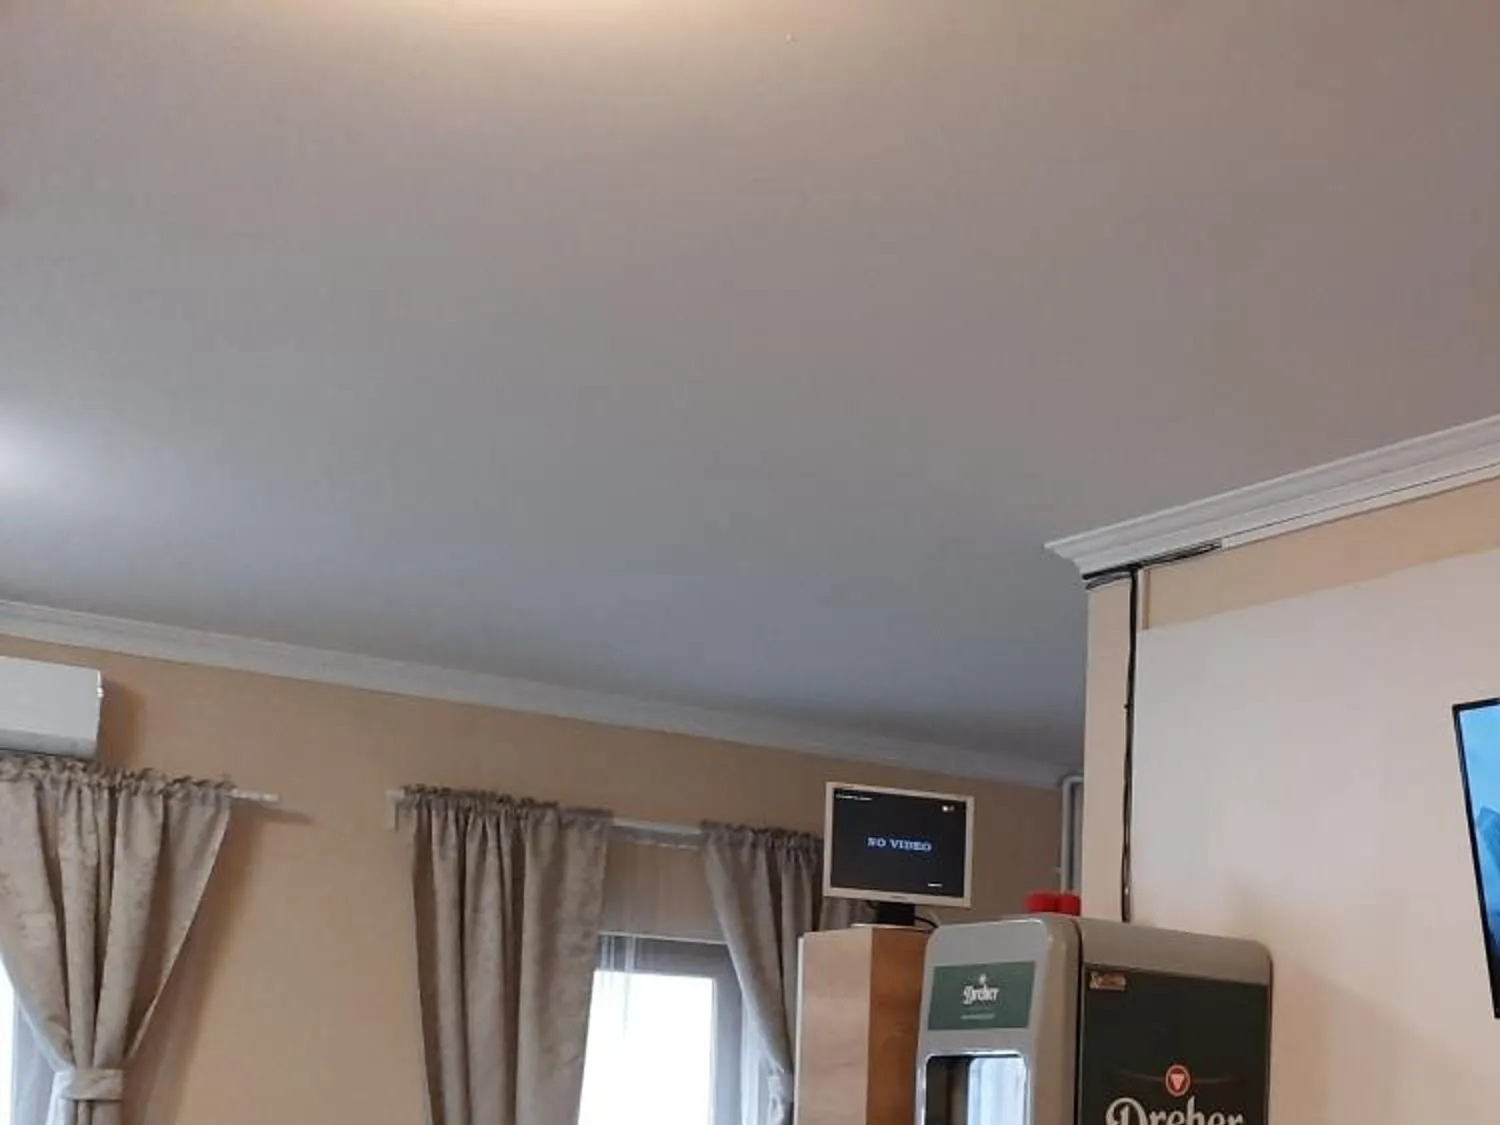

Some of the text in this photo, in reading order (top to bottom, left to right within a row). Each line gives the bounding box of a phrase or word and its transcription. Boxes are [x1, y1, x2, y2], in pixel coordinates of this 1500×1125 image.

[867, 836, 933, 852] NO VIDEO
[963, 984, 999, 1005] Dreher
